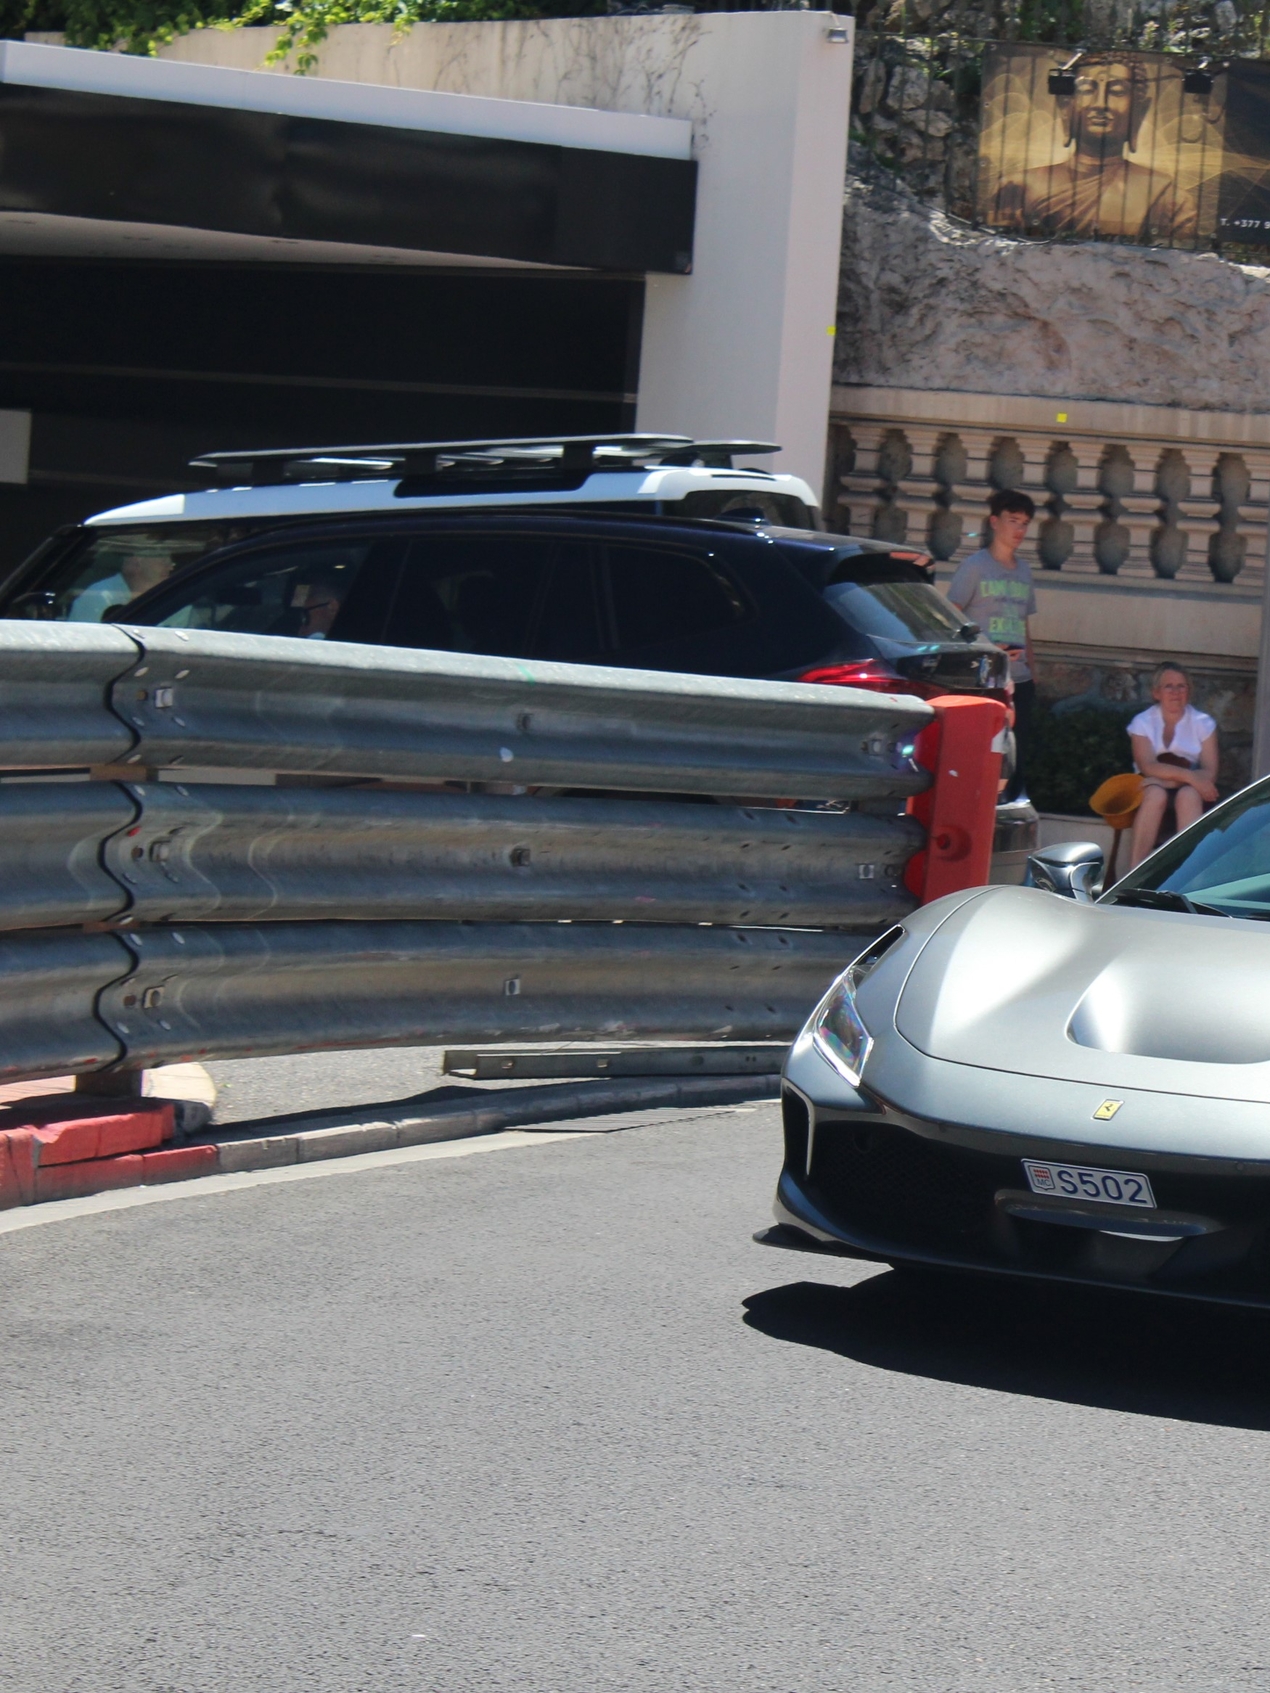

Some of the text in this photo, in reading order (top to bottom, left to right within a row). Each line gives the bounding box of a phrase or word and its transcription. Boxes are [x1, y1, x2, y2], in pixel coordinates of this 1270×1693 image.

[1220, 218, 1230, 227] T.
[1233, 219, 1261, 228] +377
[1057, 1169, 1148, 1203] S502
